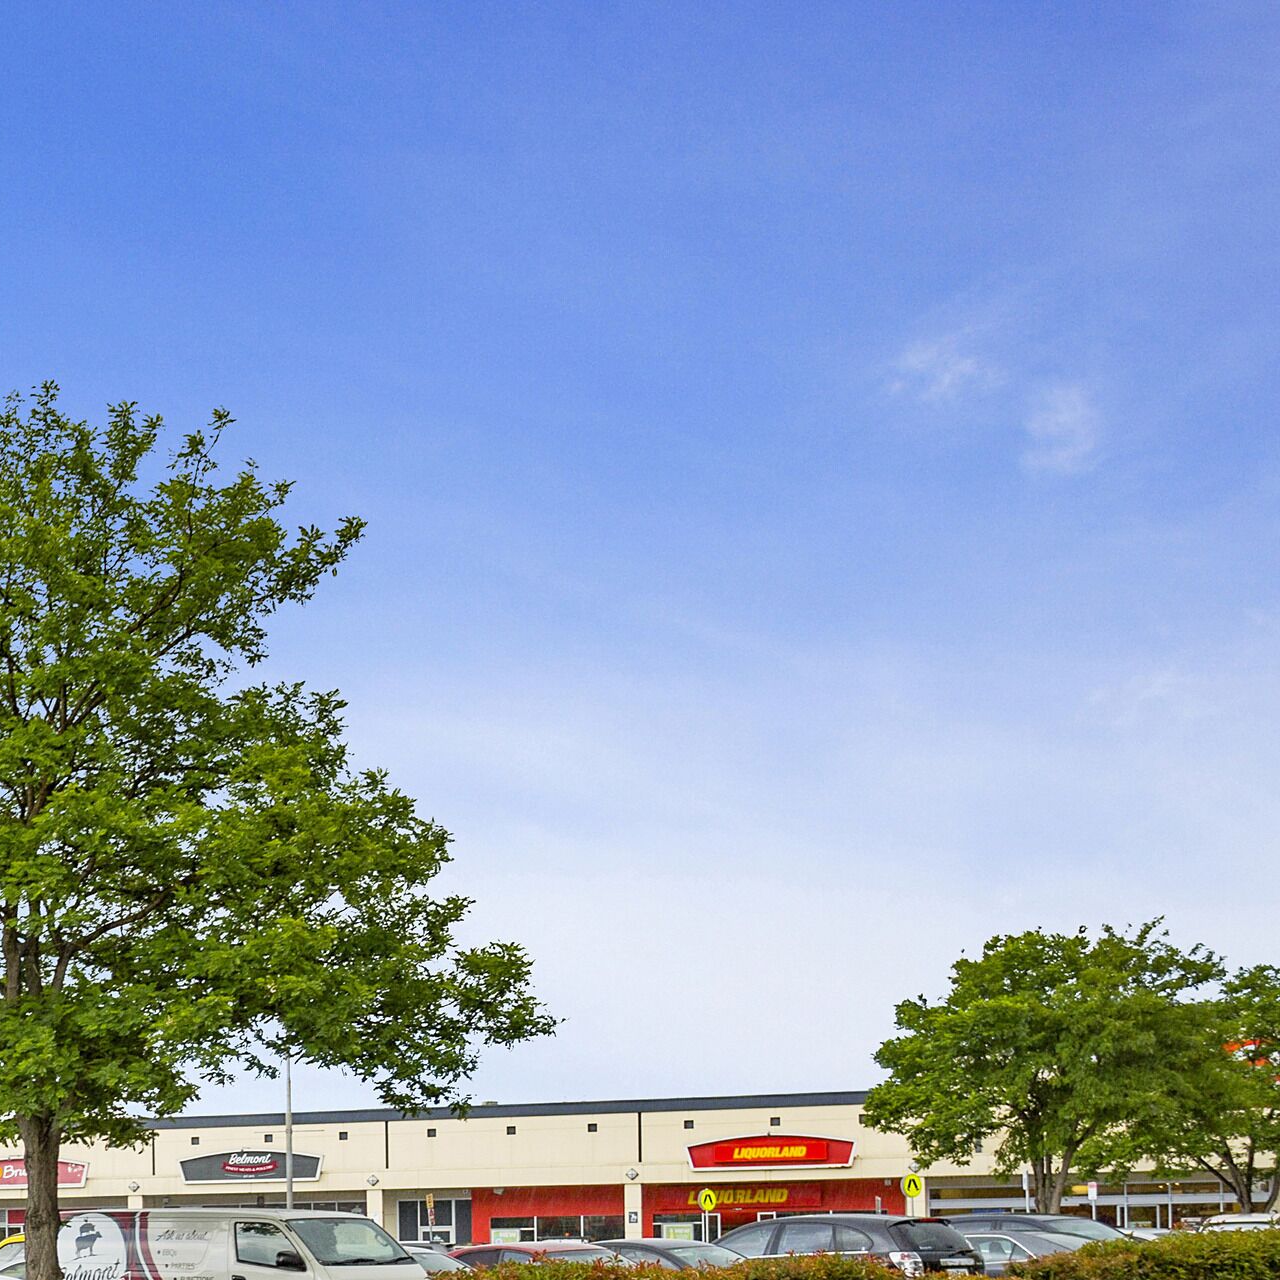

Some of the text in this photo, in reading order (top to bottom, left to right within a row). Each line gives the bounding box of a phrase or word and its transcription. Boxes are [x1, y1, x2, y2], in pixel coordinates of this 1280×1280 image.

[228, 1153, 272, 1165] Belmont
[732, 1145, 807, 1160] LIQUORLAND
[687, 1188, 788, 1205] LUORLAND
[155, 1229, 176, 1242] Ask
